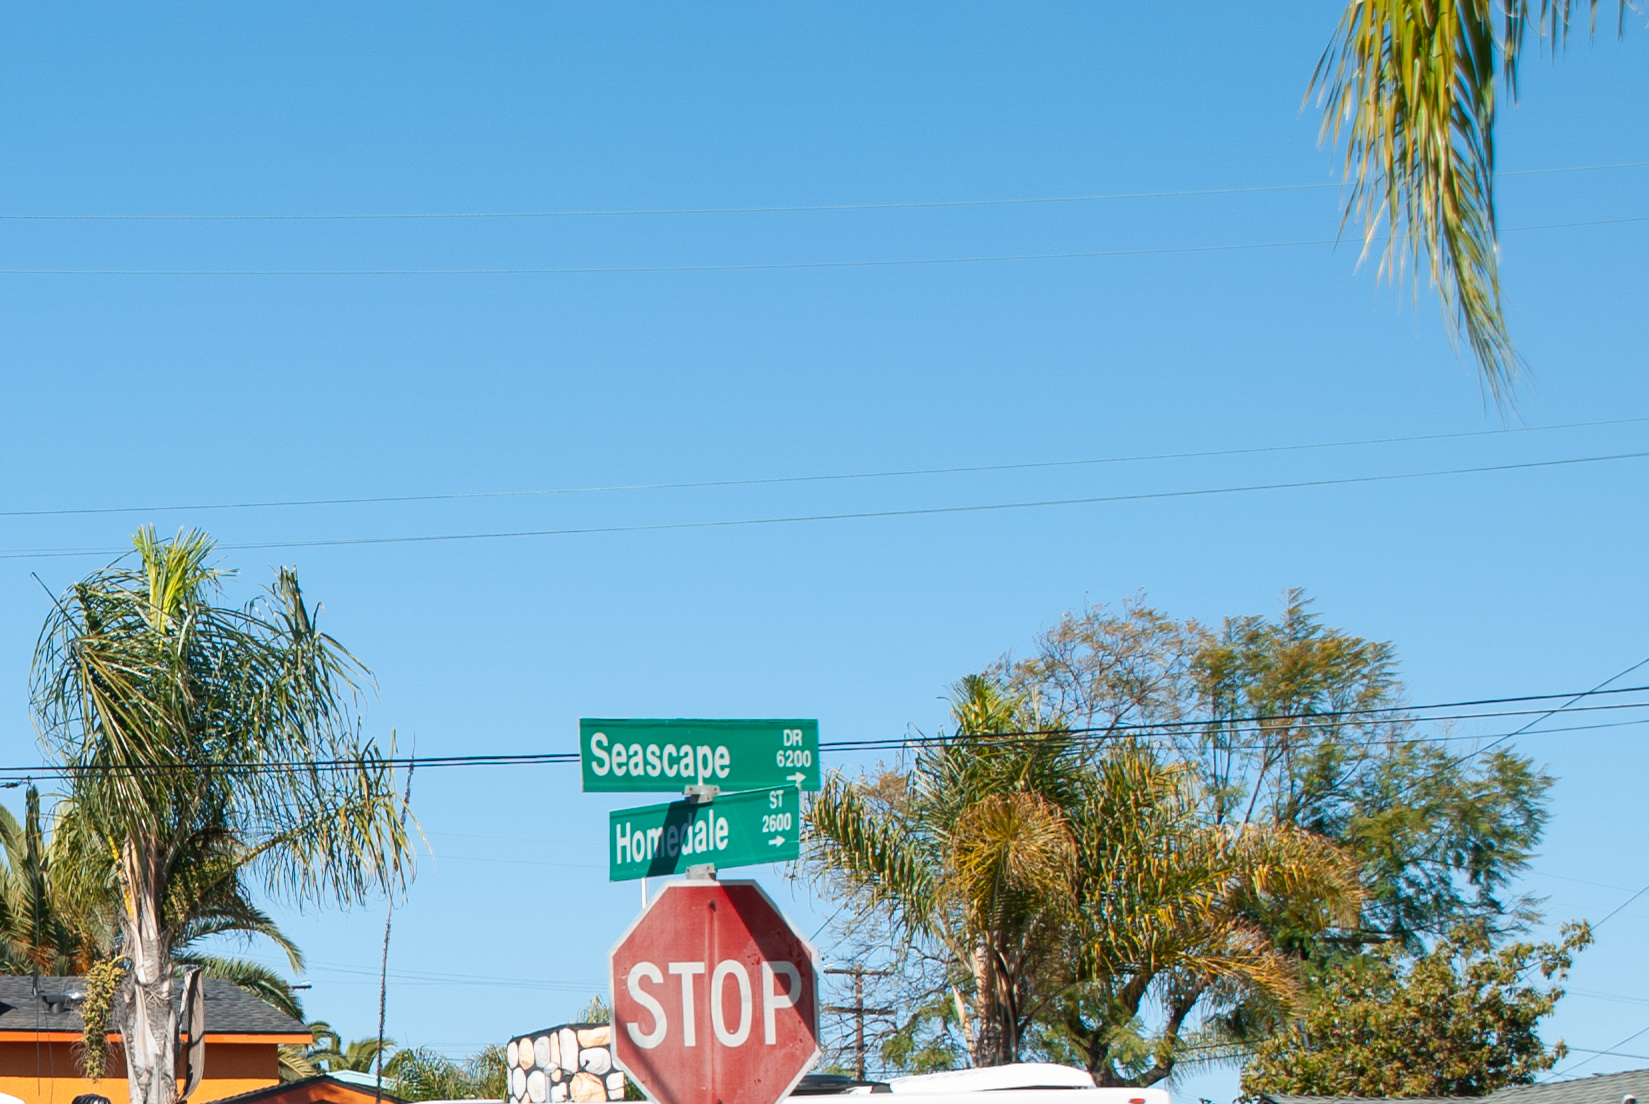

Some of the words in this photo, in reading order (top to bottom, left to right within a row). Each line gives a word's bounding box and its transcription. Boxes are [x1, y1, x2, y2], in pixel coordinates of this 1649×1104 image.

[782, 729, 803, 746] DR
[590, 731, 731, 786] Seascape
[776, 749, 812, 768] 6200
[769, 789, 784, 809] ST
[762, 812, 792, 833] 2600
[615, 808, 730, 864] Homedale
[626, 959, 802, 1049] STOP
